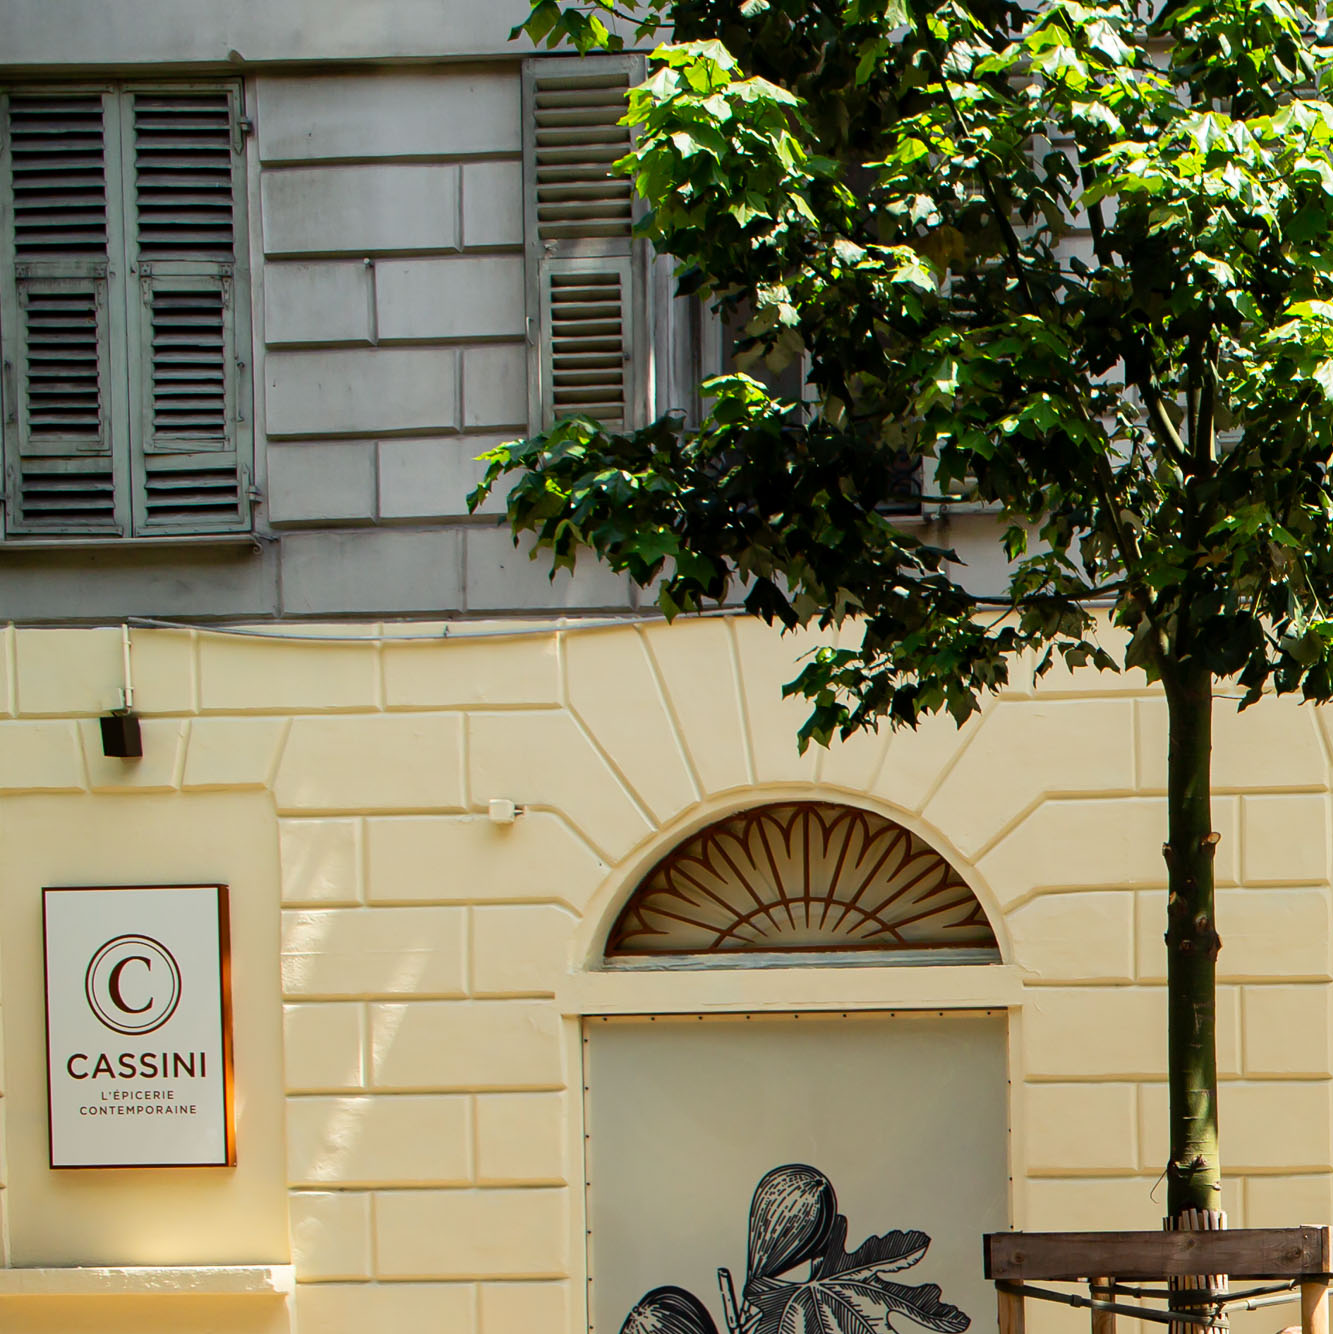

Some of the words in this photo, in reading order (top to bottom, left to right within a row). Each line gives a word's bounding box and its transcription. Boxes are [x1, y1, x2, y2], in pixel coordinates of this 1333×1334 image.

[108, 955, 154, 1014] C
[66, 1051, 207, 1080] CASSINI
[101, 1089, 175, 1101] L'ÉPICERIE
[79, 1104, 198, 1116] CONTEMPORAINE
